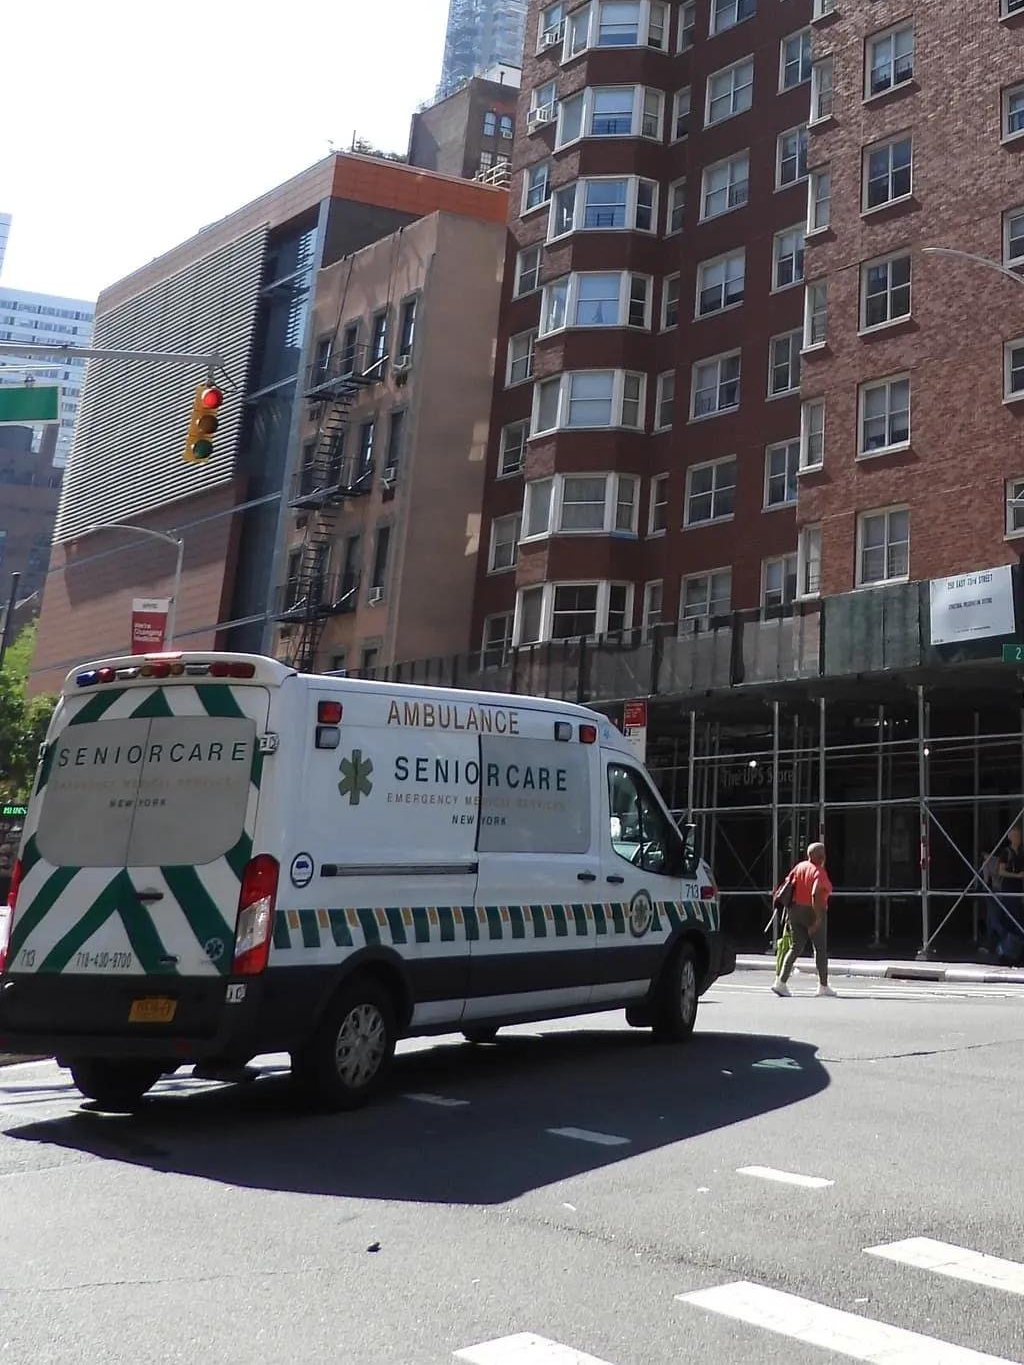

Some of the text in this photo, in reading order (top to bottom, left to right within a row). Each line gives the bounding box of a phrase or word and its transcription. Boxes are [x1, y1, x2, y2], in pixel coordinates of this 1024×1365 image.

[1015, 646, 1022, 660] 2
[387, 700, 519, 735] AMBULANCE
[58, 742, 248, 767] SENIORCARE
[394, 756, 567, 791] SENIORCARE
[722, 765, 794, 787] The UPS Sore
[109, 797, 167, 808] NEW YORK
[387, 793, 459, 805] EMERGENCY
[451, 815, 507, 825] NEW YORK
[685, 883, 699, 898] 713
[20, 949, 36, 967] 713
